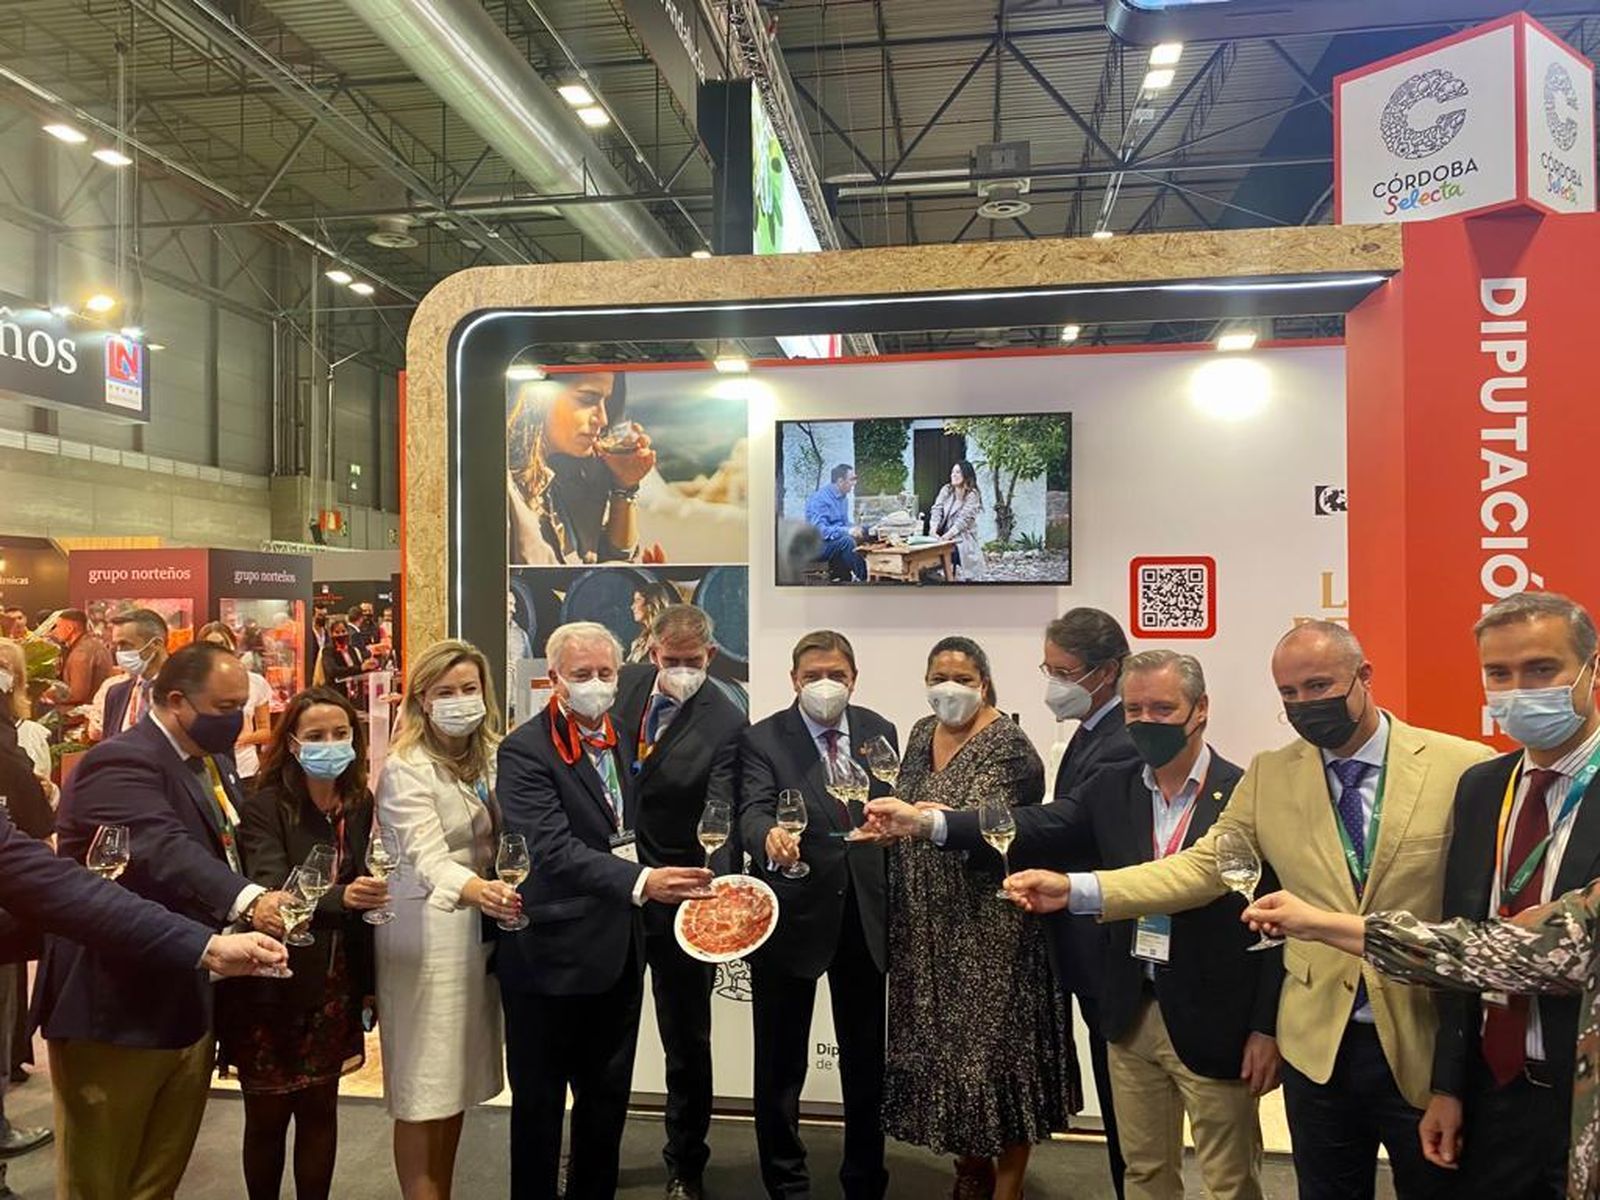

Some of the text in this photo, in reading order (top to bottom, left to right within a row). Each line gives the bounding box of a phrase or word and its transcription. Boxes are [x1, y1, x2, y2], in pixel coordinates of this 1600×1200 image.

[1372, 157, 1479, 199] CÓRDOBA
[1541, 151, 1583, 187] CÓRDOBA
[1384, 178, 1465, 215] Selecta
[1480, 277, 1545, 614] DIPUTACIÓ
[88, 566, 192, 585] grupo norteños
[233, 569, 297, 585] grupo norteños
